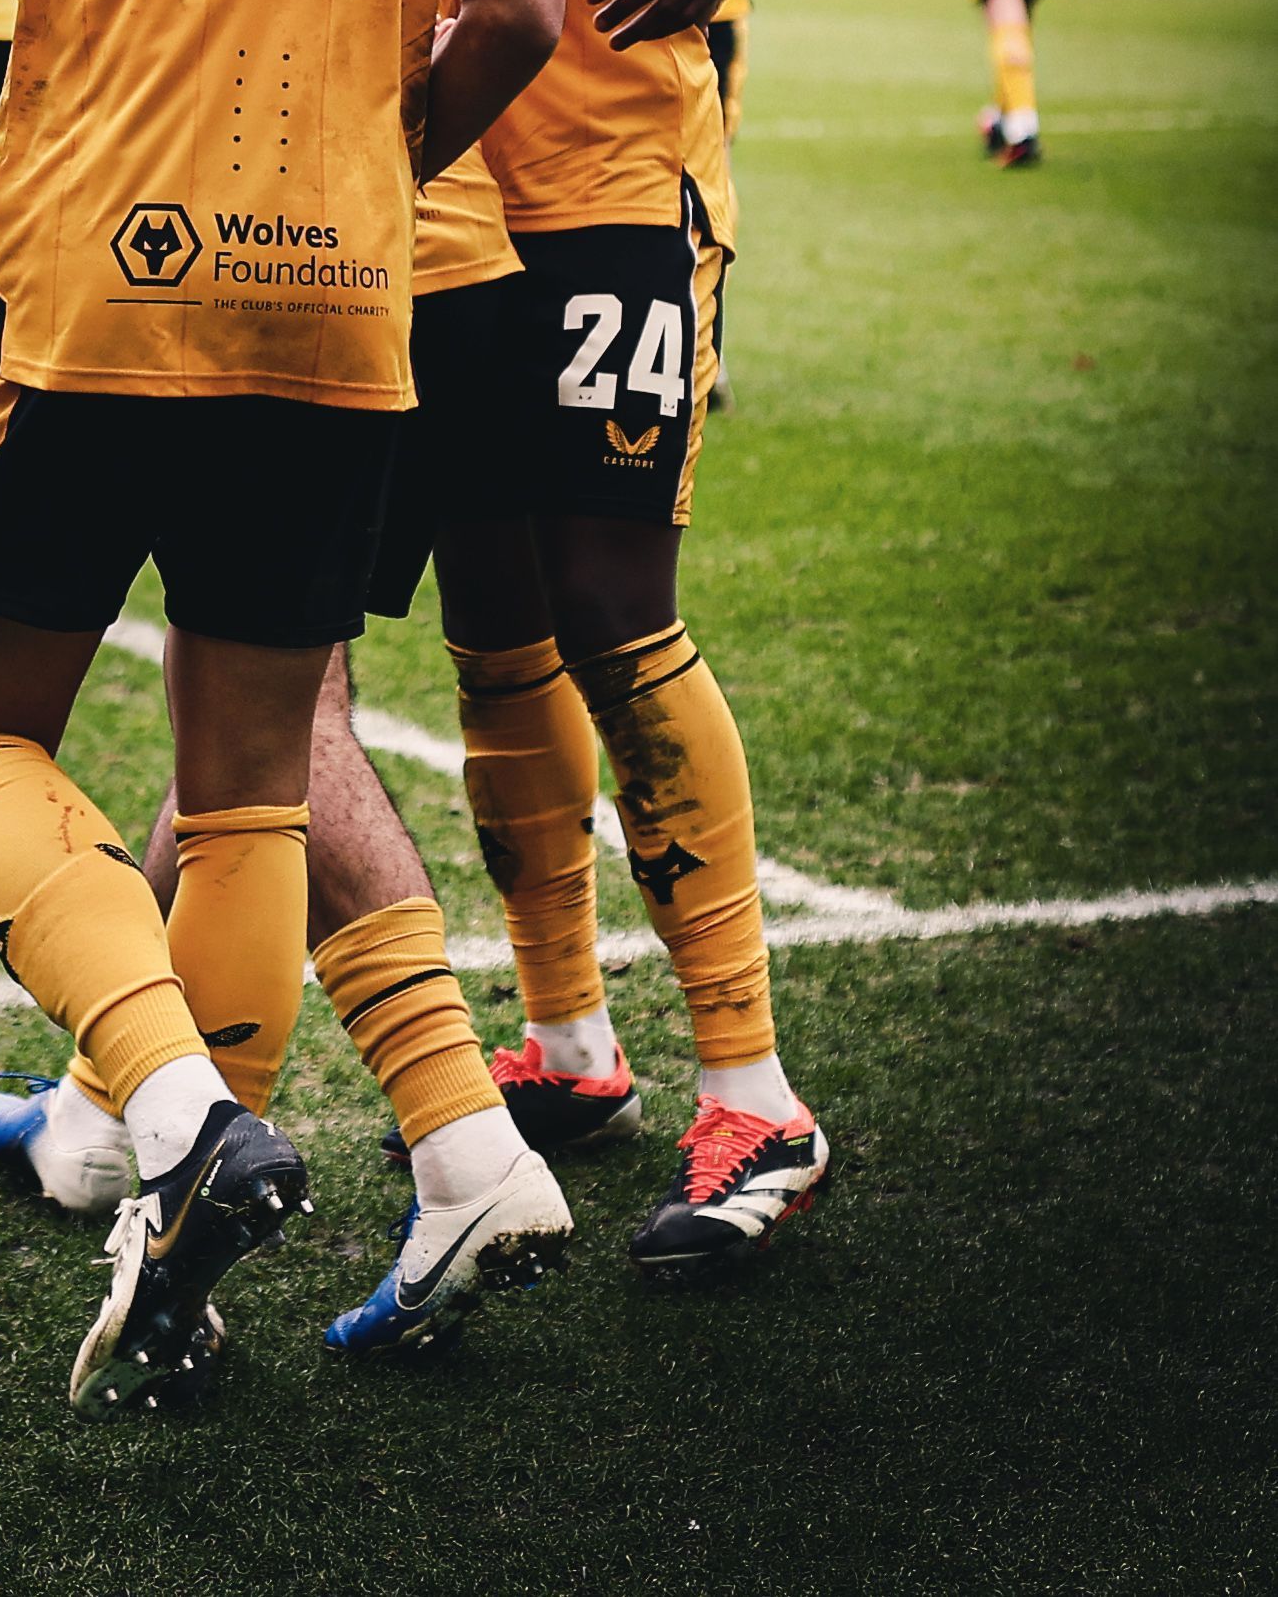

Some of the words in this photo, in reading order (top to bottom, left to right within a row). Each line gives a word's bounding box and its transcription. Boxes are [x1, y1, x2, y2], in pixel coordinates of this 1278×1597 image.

[214, 213, 339, 249] Wolves
[213, 251, 389, 290] Foundation
[213, 298, 237, 310] THE
[241, 299, 283, 312] CLUB'S
[287, 302, 343, 315] OFFICIAL
[347, 304, 390, 317] CHARITY
[557, 293, 685, 418] 24
[603, 455, 655, 469] CASTORE
